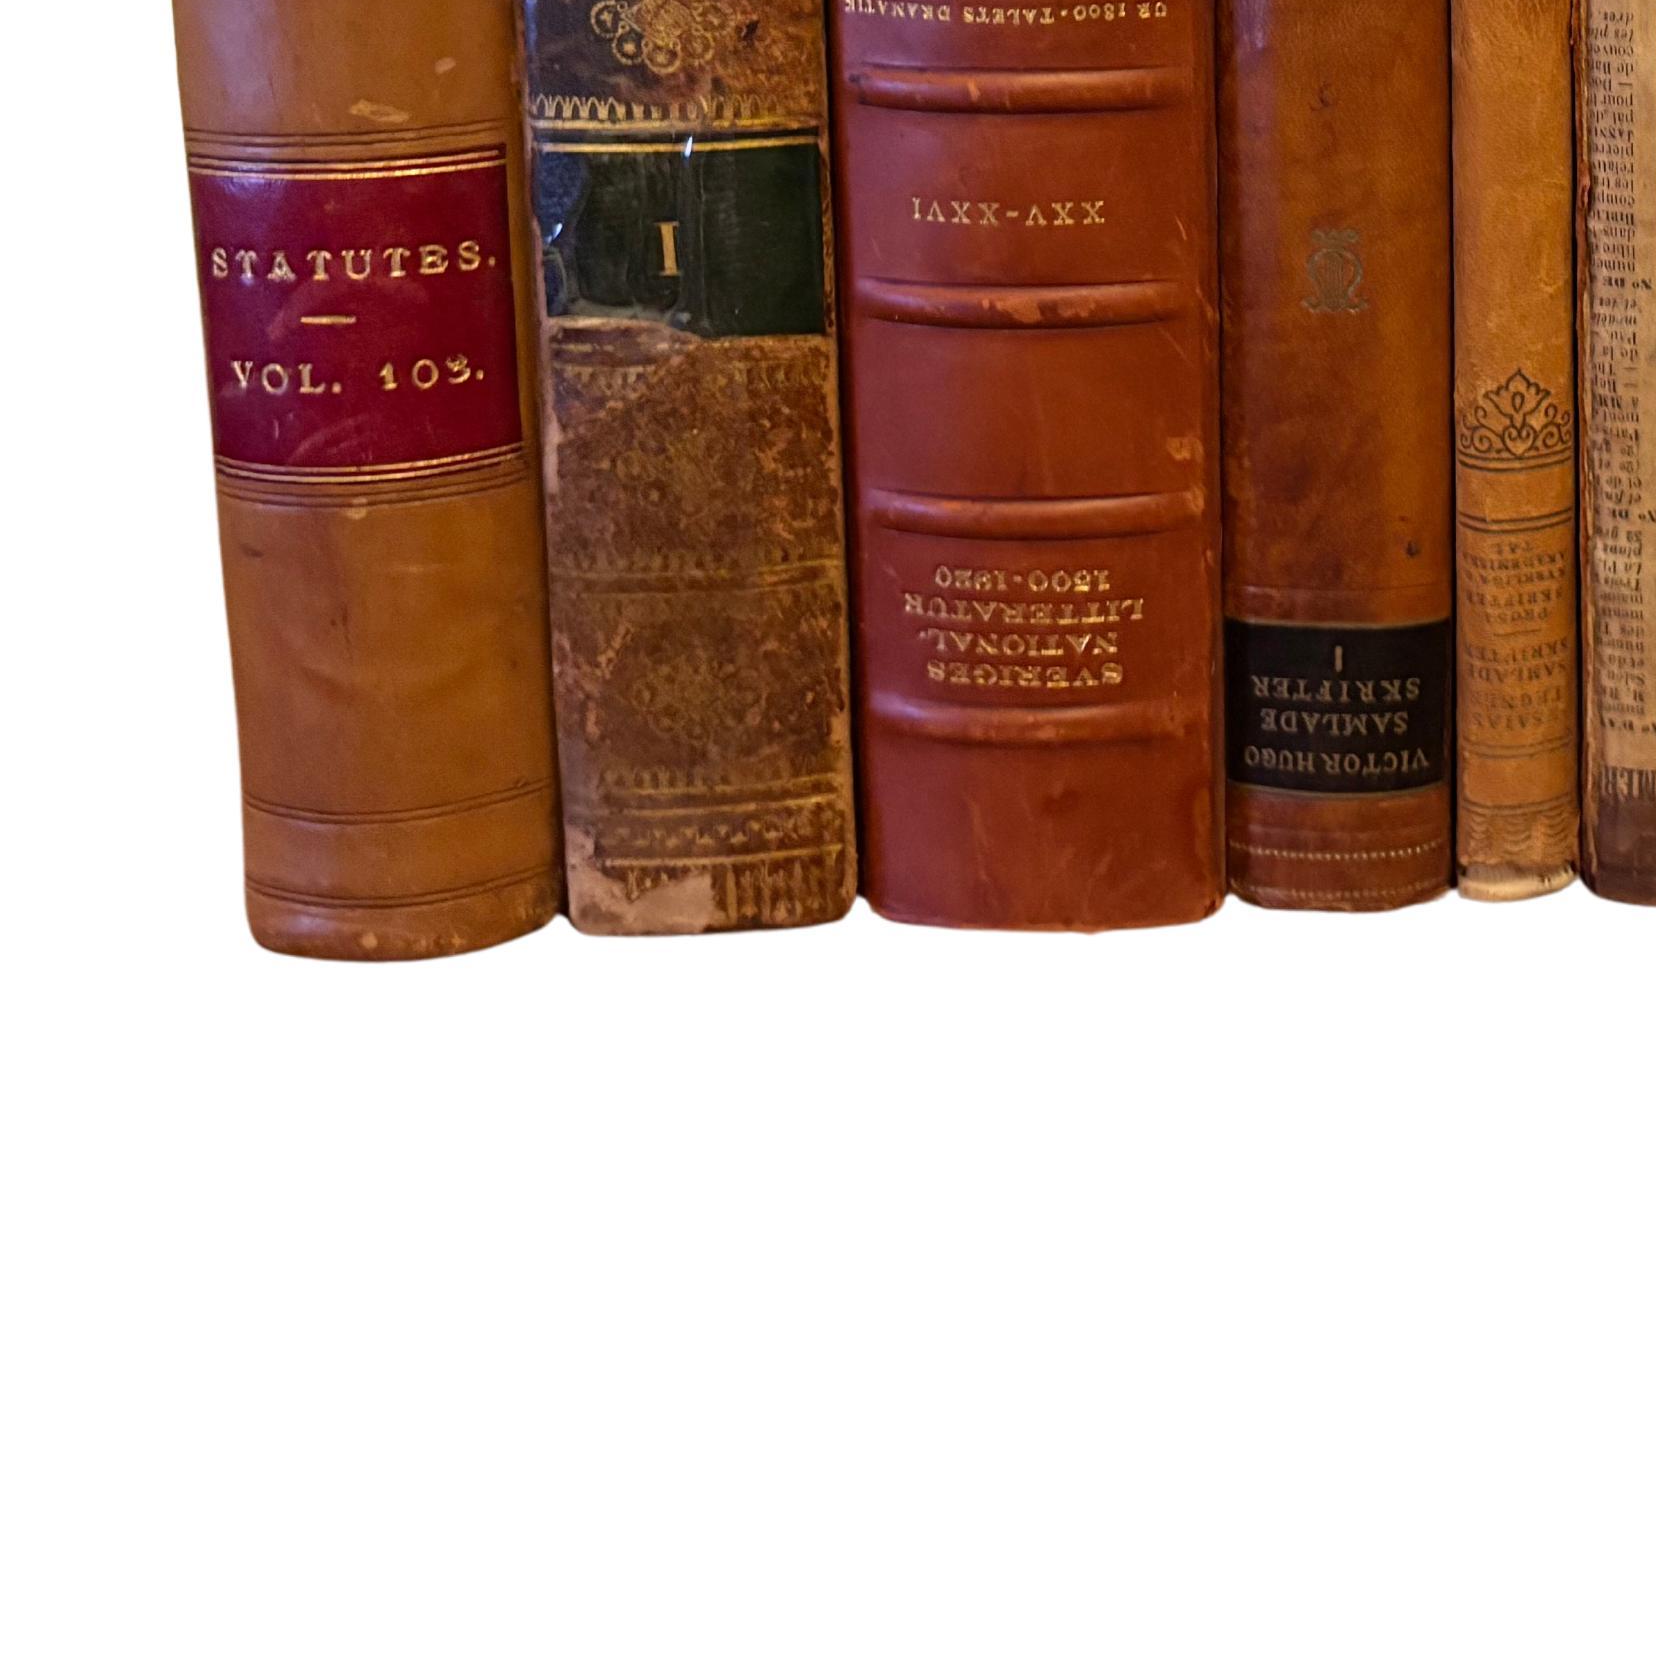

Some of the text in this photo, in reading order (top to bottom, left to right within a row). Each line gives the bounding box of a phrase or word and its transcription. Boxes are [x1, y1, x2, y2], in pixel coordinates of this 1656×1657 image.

[1136, 1, 1168, 19] UR
[909, 196, 1106, 227] XXV-XXVI
[210, 240, 497, 281] STATUTES.
[654, 221, 682, 276] I
[230, 353, 485, 394] VOL. 103.
[934, 564, 1110, 593] 1500-1920
[901, 592, 1144, 625] LITTERATUR
[925, 658, 1124, 689] SVERIGES
[1250, 674, 1422, 704] SKRIFTER
[1258, 707, 1409, 738] SAMLADE
[1243, 744, 1430, 776] VICTOR HUGO
